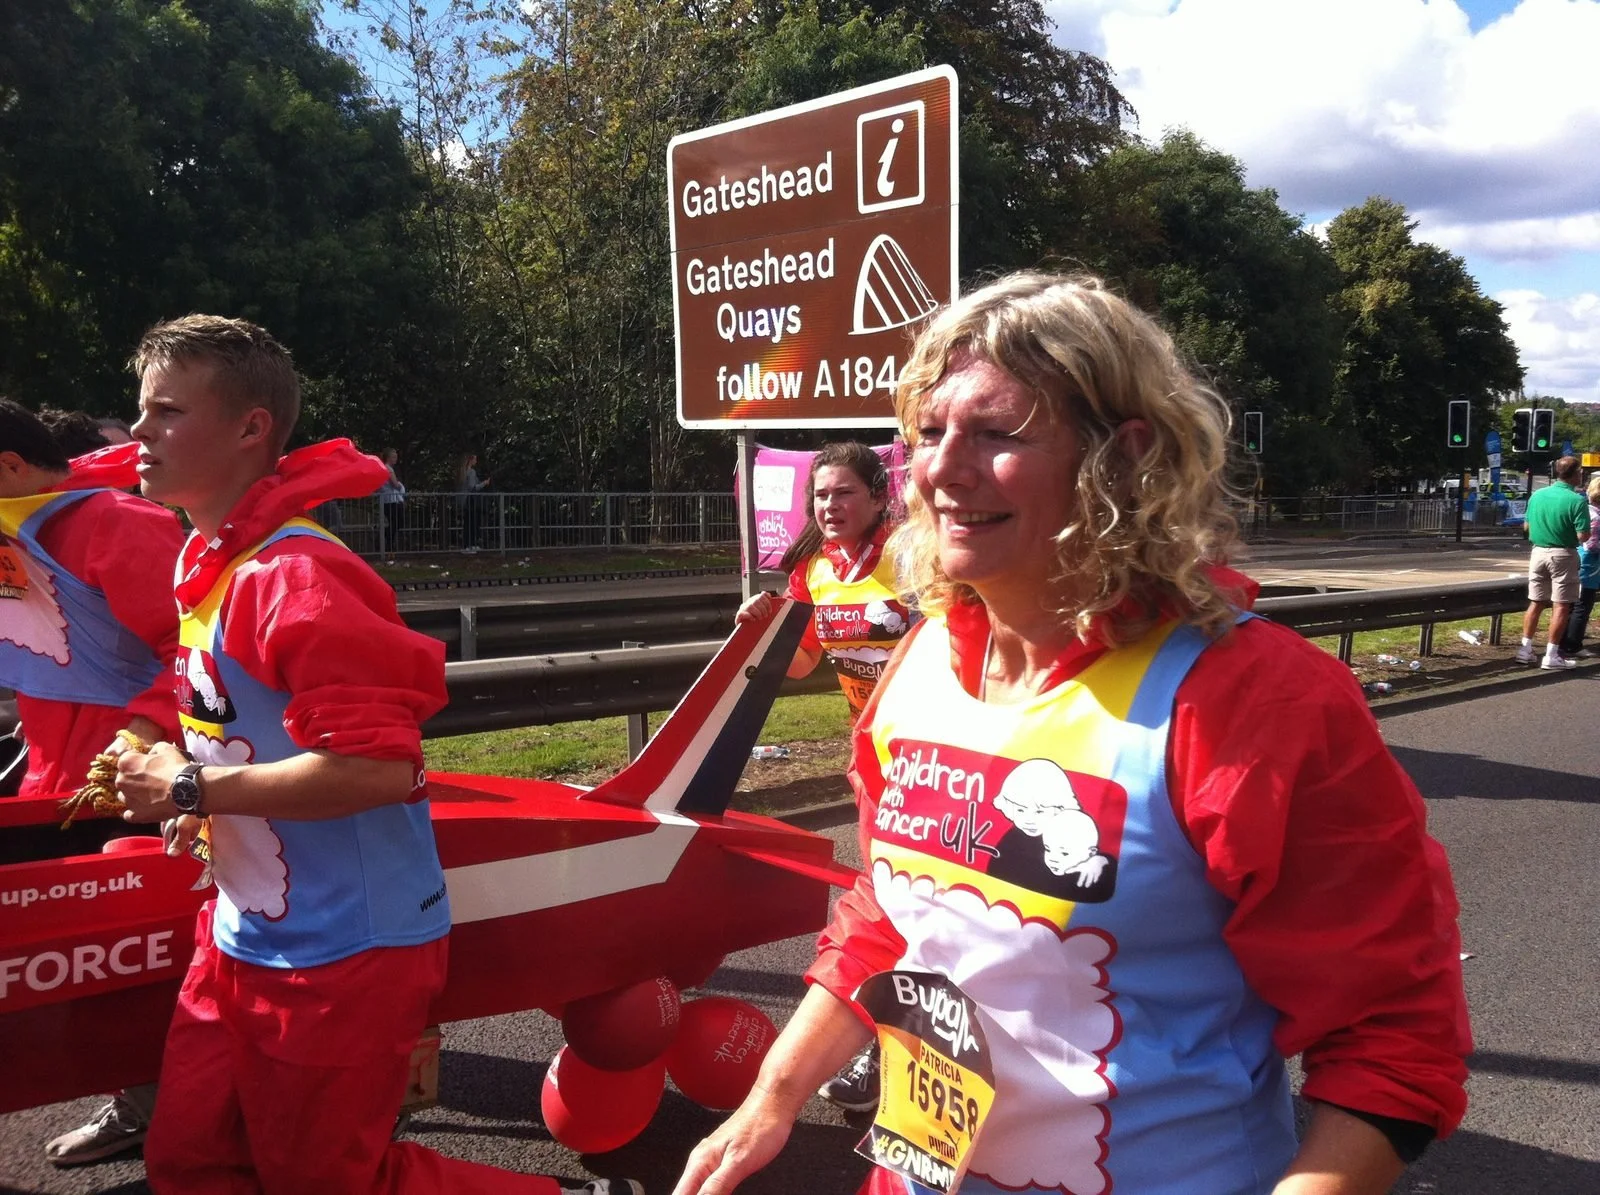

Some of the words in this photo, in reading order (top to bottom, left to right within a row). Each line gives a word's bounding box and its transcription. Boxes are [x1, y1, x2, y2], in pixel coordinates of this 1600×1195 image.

[682, 150, 834, 218] Gateshead
[686, 238, 835, 295] Gateshead
[717, 303, 801, 343] Quays
[717, 363, 802, 400] follow
[816, 606, 861, 623] children
[843, 658, 875, 676] Bupa
[890, 746, 985, 803] children
[940, 801, 1000, 864] uk
[0, 930, 174, 1000] FORCE
[892, 974, 961, 1030] Bupa
[728, 1010, 745, 1042] cancer
[732, 1017, 762, 1064] children
[713, 1041, 734, 1063] uk
[920, 1045, 963, 1086] PATRICIA
[907, 1060, 979, 1142] 15958
[928, 1135, 957, 1161] PUMA
